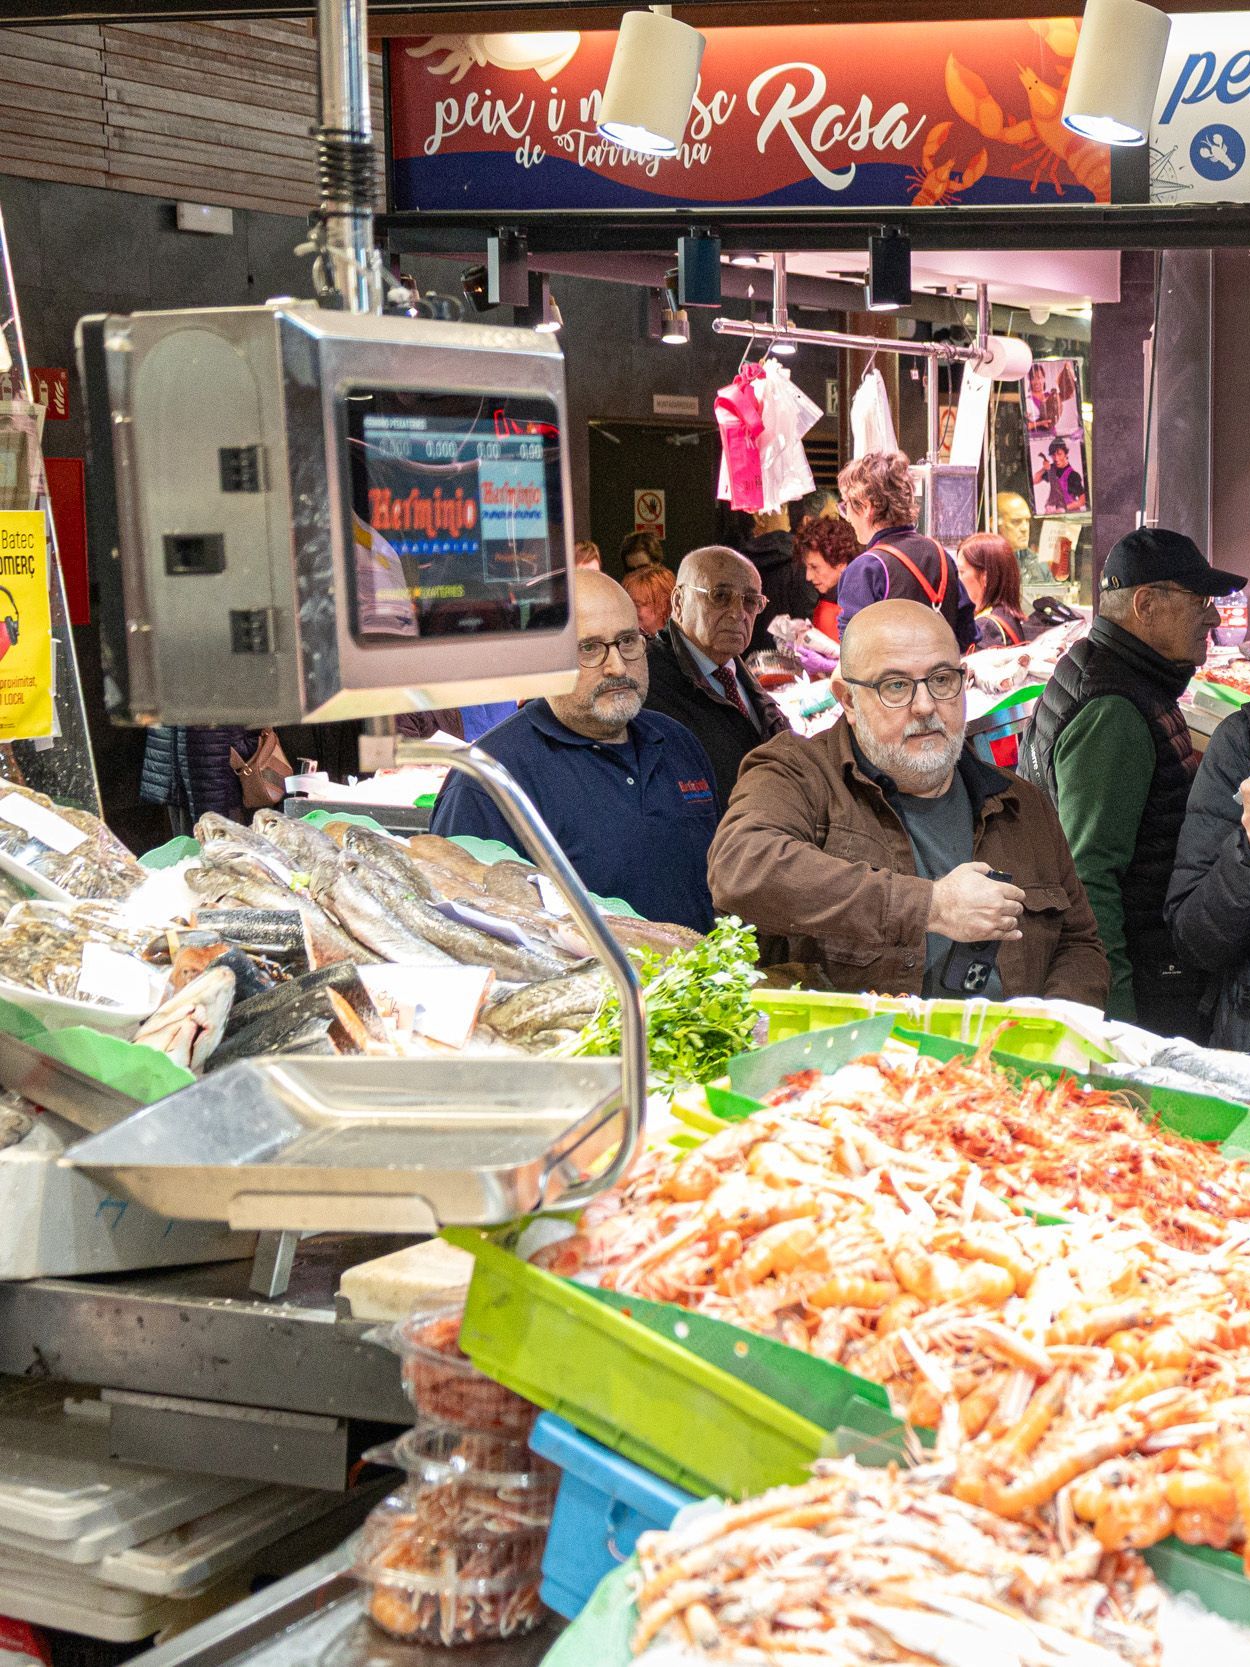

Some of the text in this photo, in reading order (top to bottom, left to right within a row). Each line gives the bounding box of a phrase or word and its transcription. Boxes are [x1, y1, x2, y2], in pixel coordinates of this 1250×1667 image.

[424, 87, 535, 155] peix
[547, 87, 566, 132] i
[747, 62, 926, 191] Rosa
[515, 136, 546, 168] de
[2, 529, 35, 550] Batec
[4, 692, 25, 706] LOCAL
